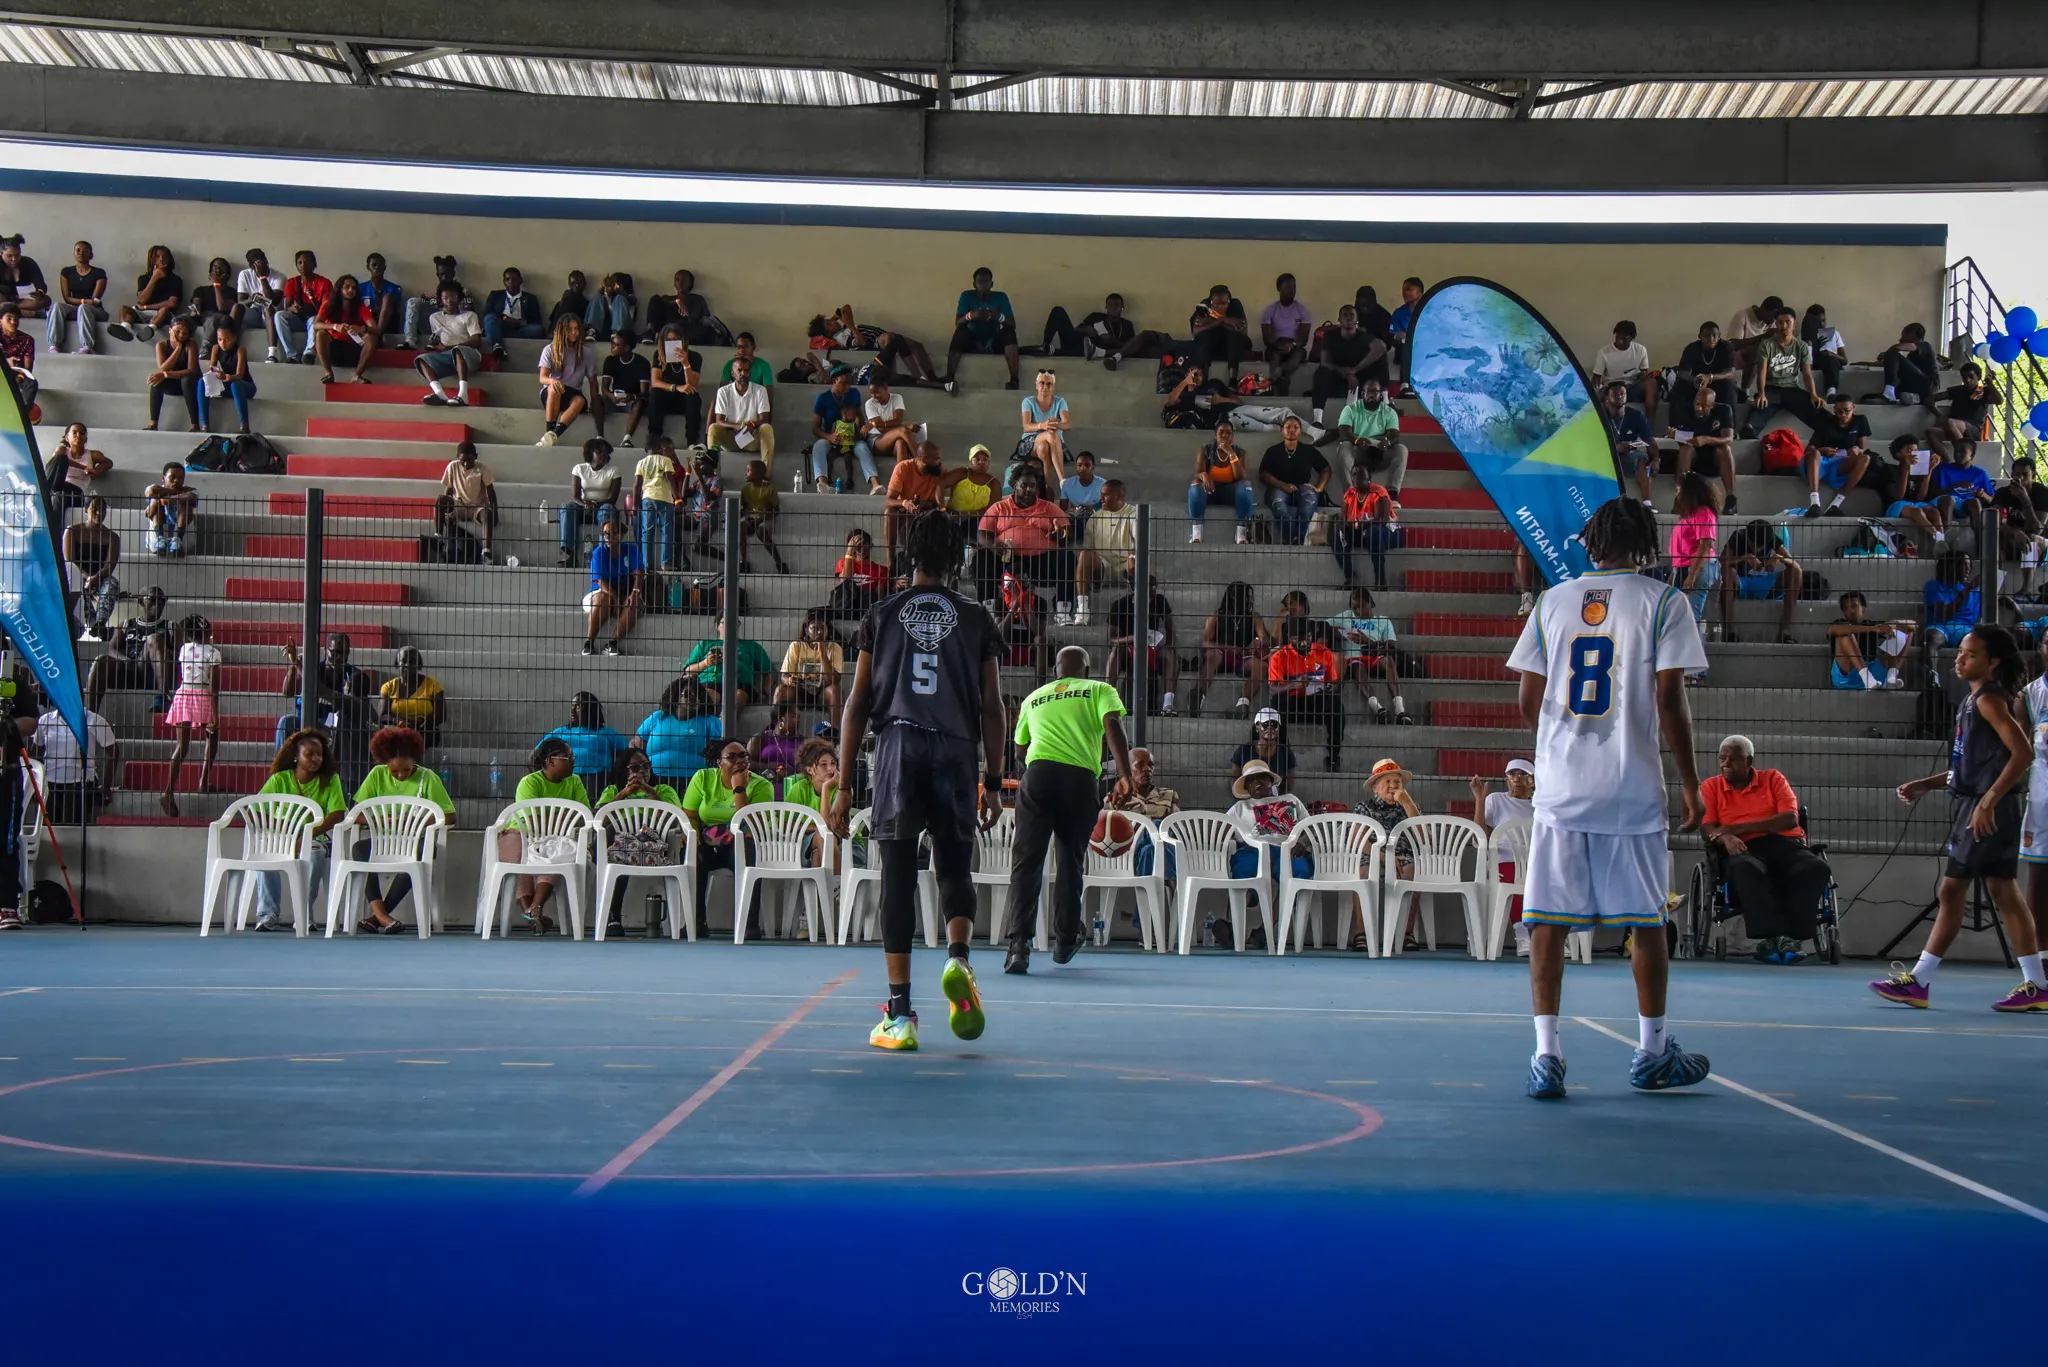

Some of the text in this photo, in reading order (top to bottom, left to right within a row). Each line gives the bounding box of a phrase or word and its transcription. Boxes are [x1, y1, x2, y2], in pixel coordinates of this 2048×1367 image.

[911, 653, 939, 696] 5
[1566, 632, 1618, 719] 8
[1030, 689, 1092, 709] REFEREE
